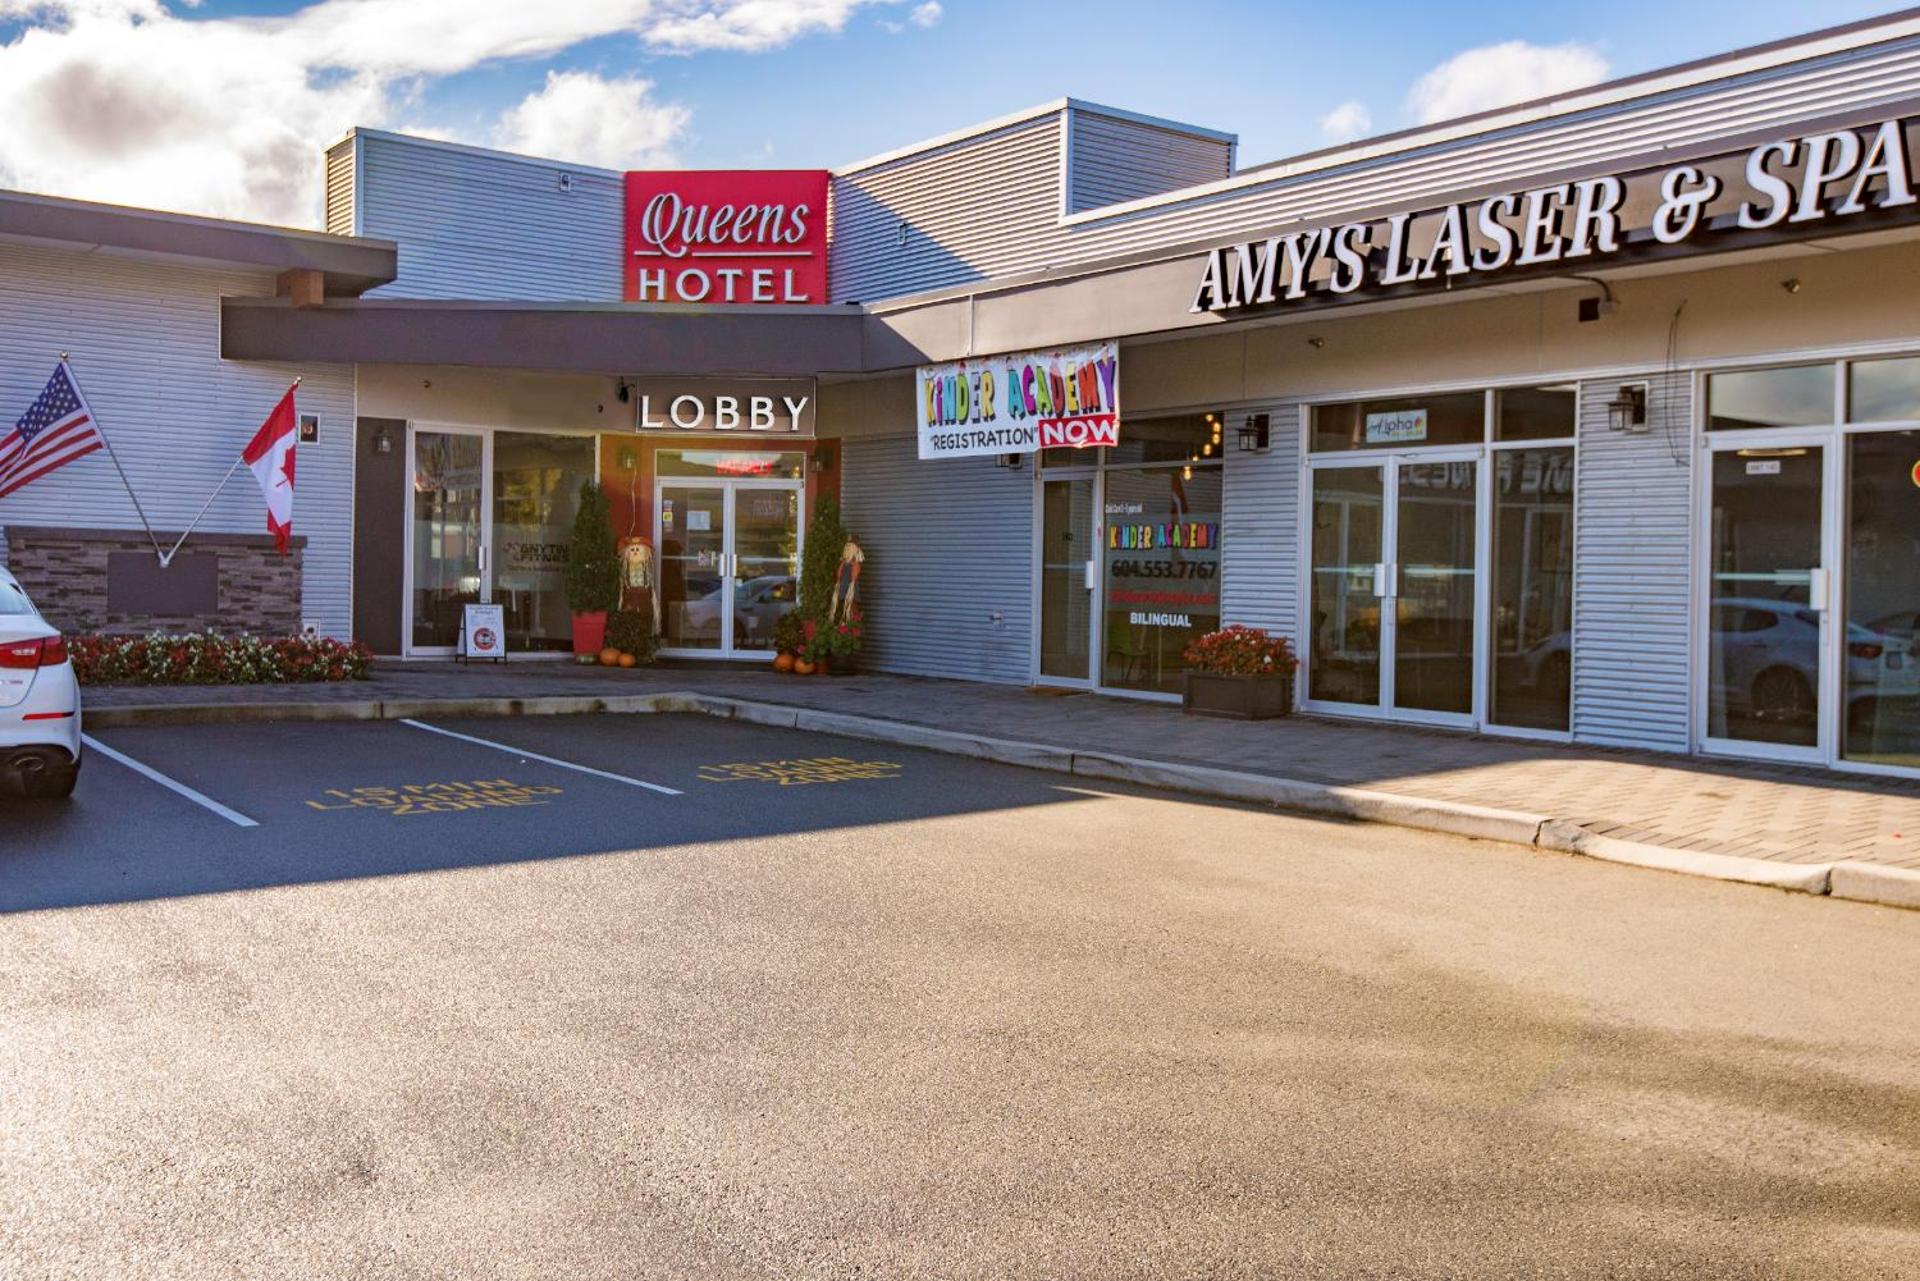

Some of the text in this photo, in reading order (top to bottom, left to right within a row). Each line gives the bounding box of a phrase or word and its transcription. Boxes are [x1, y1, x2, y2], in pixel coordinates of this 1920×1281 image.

[642, 191, 811, 258] Queens
[1189, 119, 1918, 313] AMY'S LASER & SPA
[638, 267, 809, 302] HOTEL
[1009, 354, 1116, 420] ACADEMY
[640, 394, 810, 432] LOBBY
[1042, 419, 1119, 444] NOW
[1157, 521, 1218, 549] ACADEMY
[1111, 559, 1218, 579] 604.553.7767
[1129, 611, 1193, 628] BILINGUAL
[304, 786, 564, 811] LOADING
[401, 778, 518, 794] MIN
[376, 795, 550, 816] ZONE
